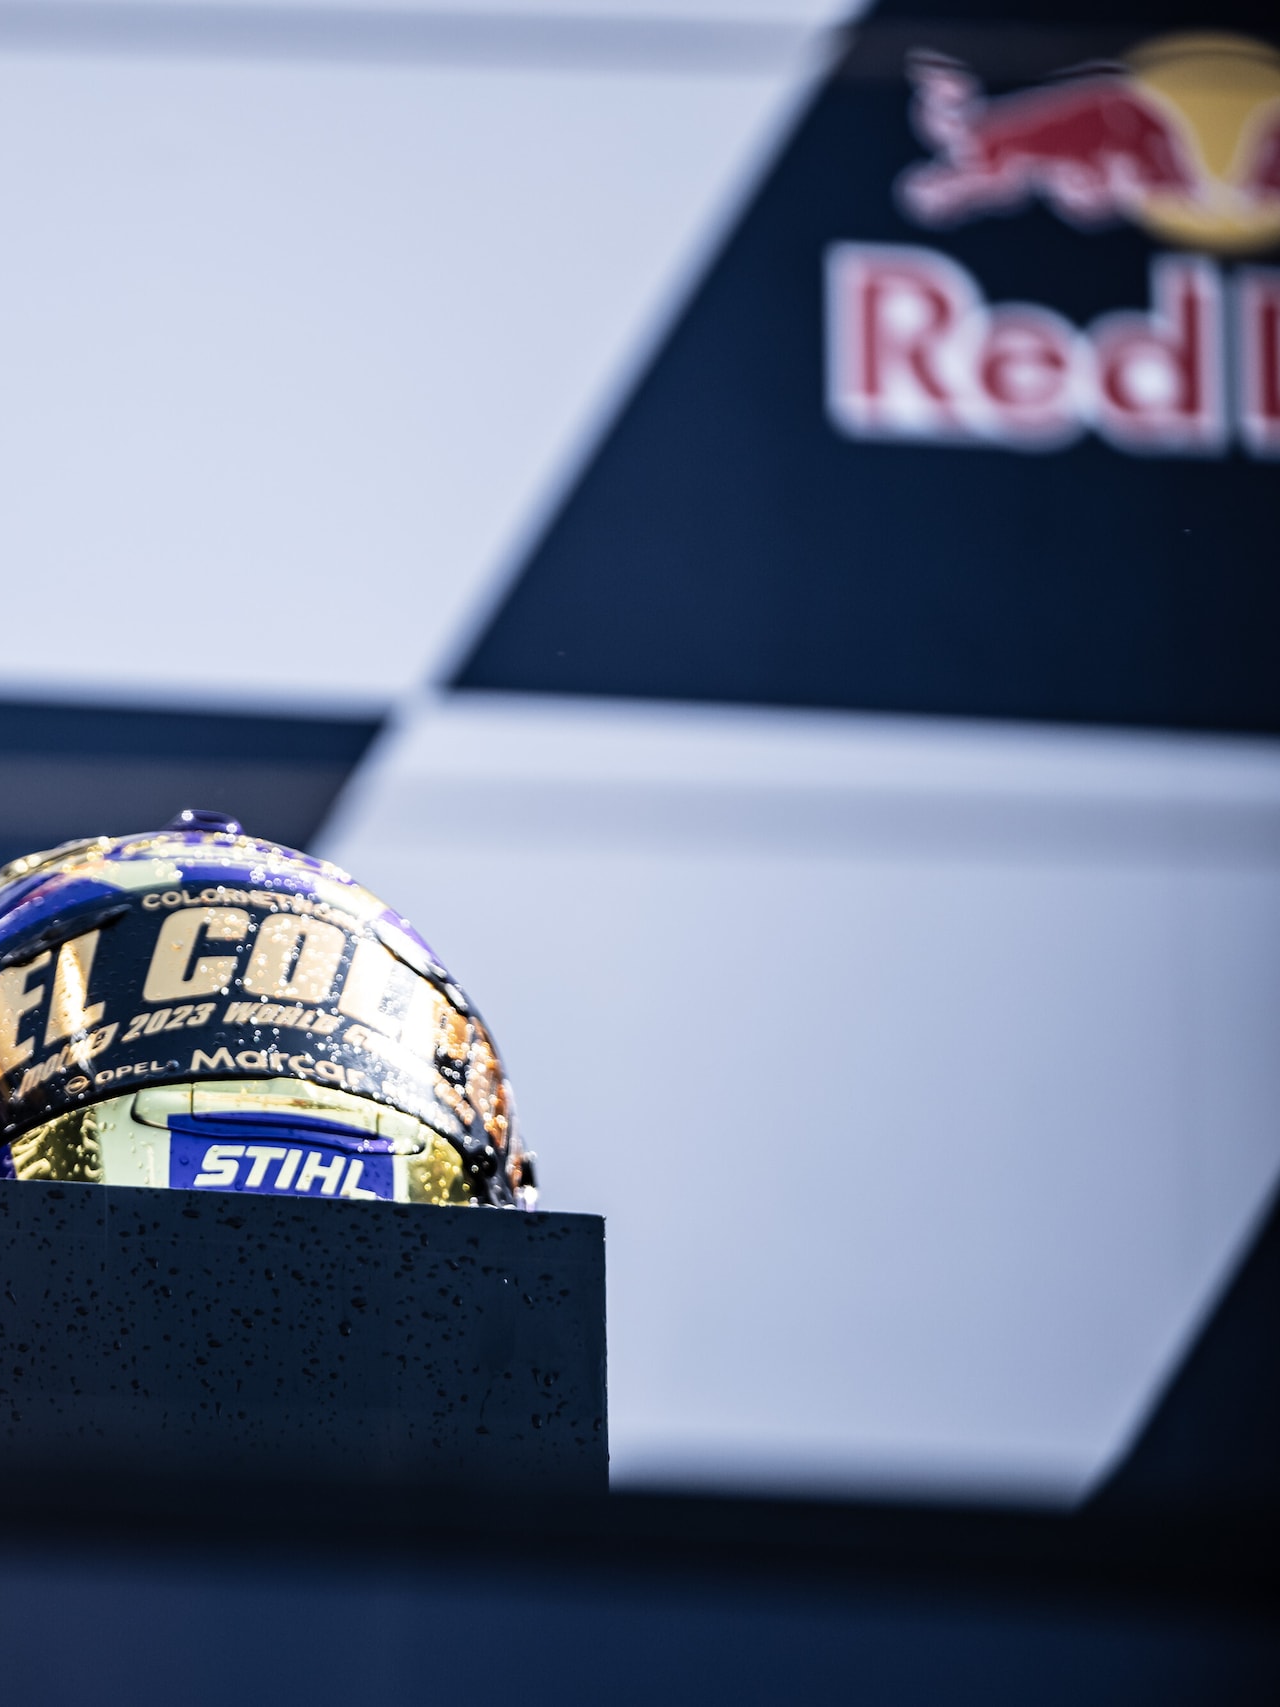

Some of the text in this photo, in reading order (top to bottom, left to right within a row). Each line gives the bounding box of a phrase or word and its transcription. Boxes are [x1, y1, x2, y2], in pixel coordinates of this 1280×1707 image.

[826, 240, 1228, 460] Red
[121, 1002, 217, 1043] 2023
[222, 1001, 346, 1034] WORLD
[95, 1060, 165, 1086] OPEL
[193, 1144, 376, 1200] STIHL
